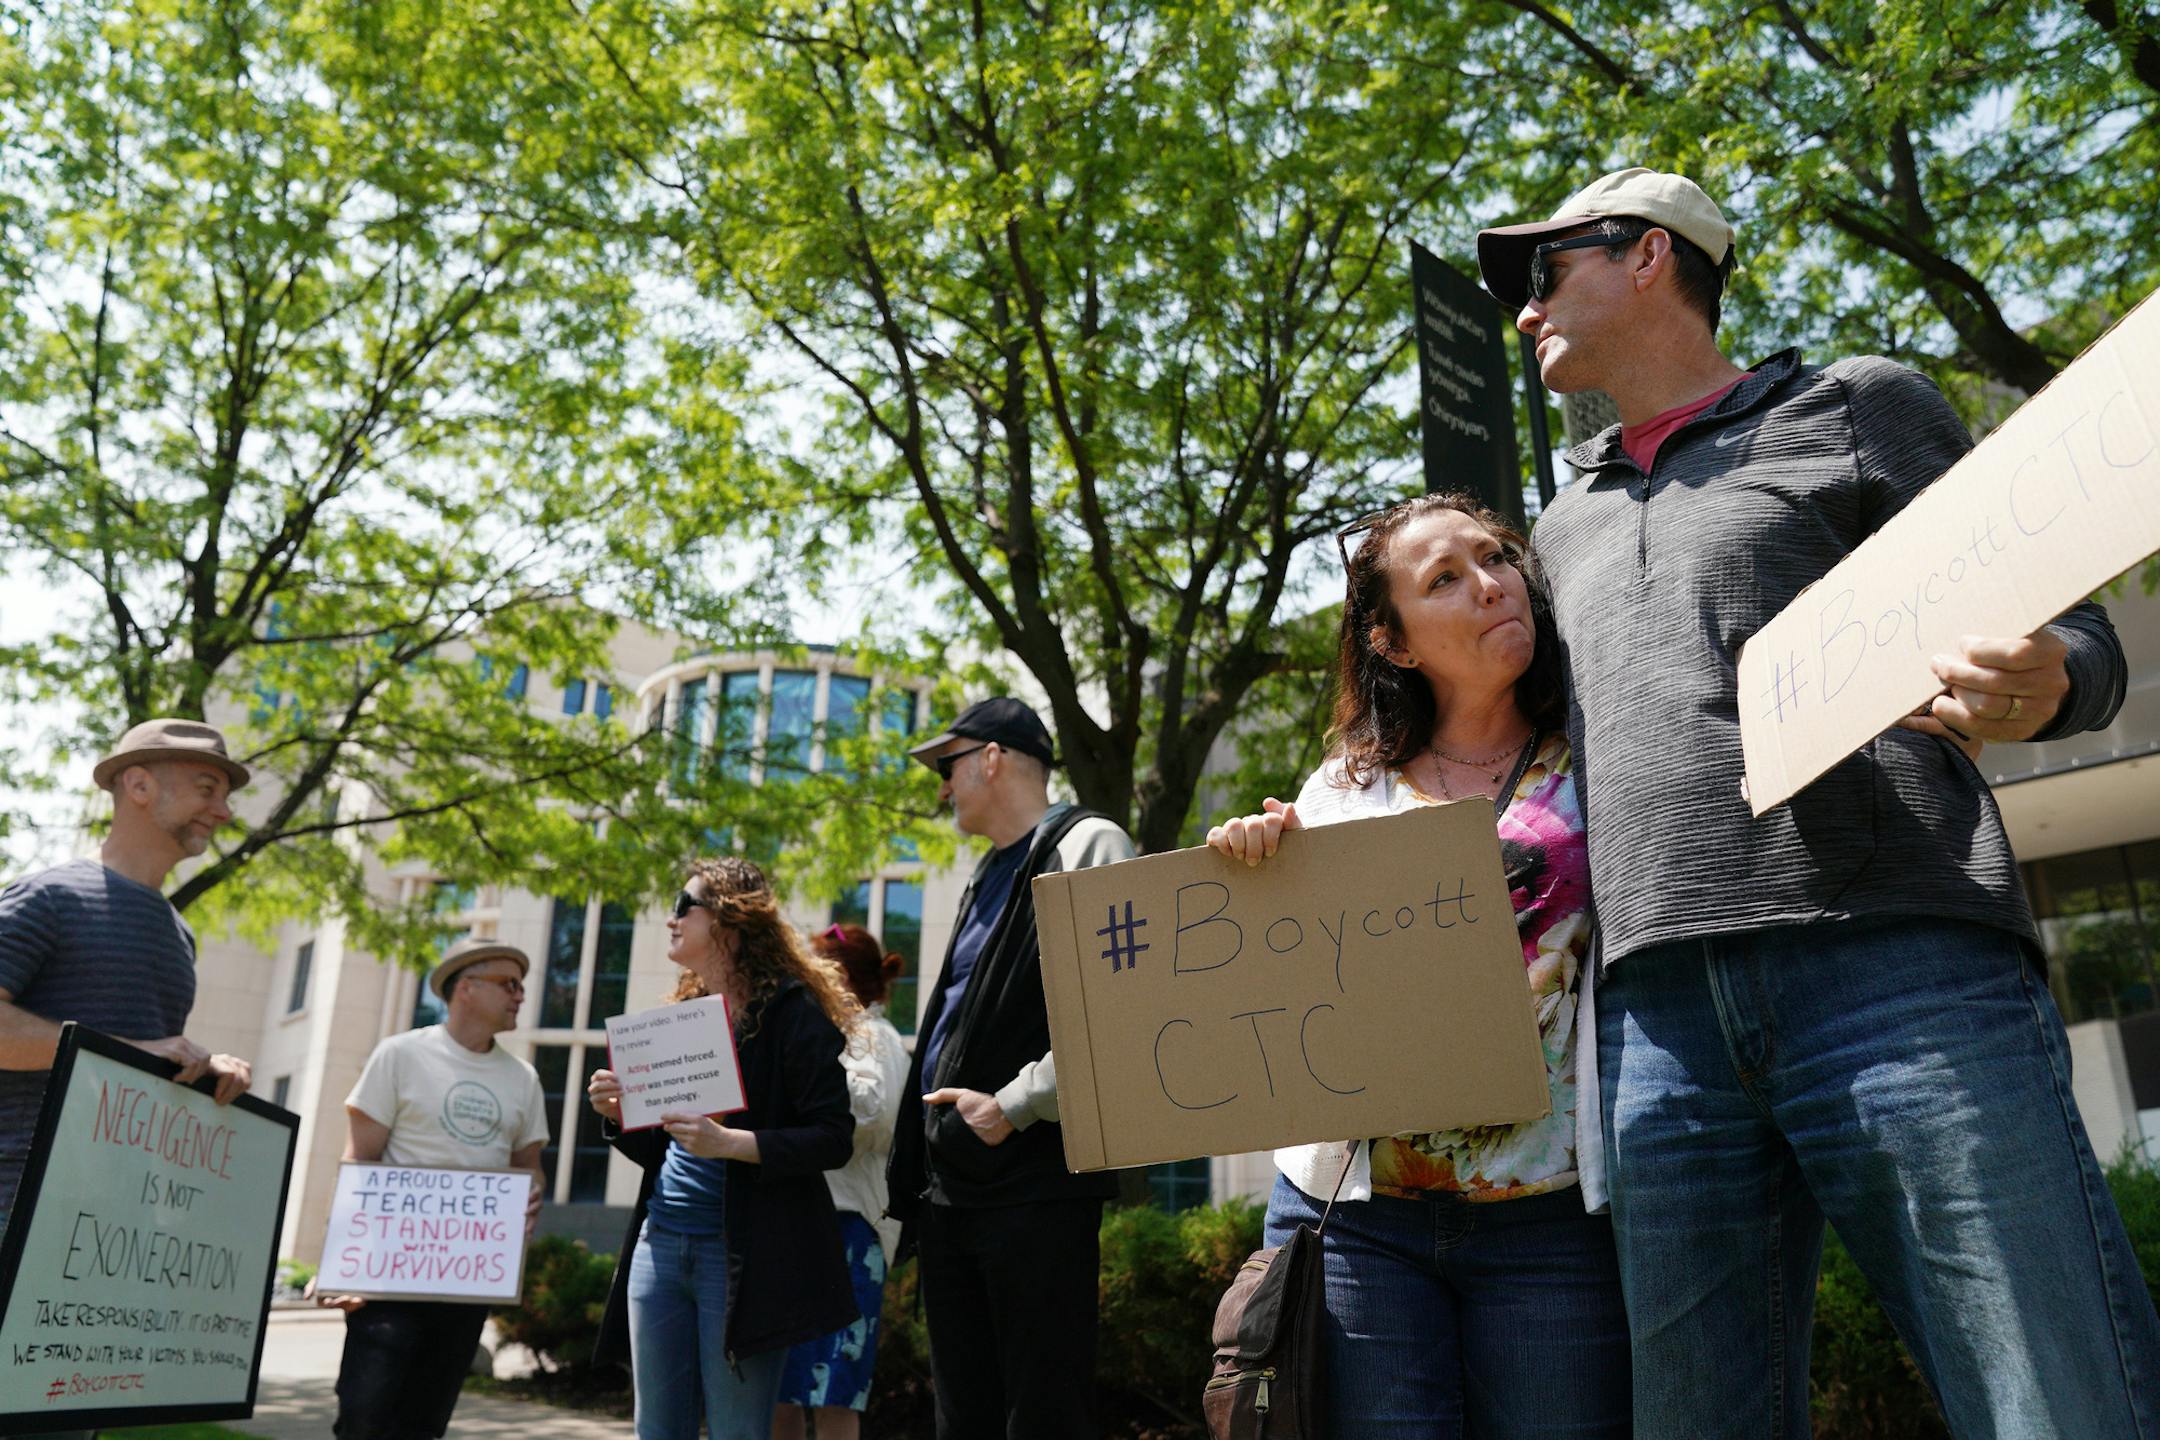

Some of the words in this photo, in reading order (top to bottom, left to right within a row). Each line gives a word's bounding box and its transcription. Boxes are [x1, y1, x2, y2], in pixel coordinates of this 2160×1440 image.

[616, 1026, 630, 1035] saw
[631, 1022, 648, 1034] your
[649, 1016, 673, 1029] video.
[677, 1008, 706, 1022] Here's
[614, 1043, 626, 1053] my
[1154, 1003, 1365, 1109] CTC
[627, 1063, 651, 1075] Acting
[651, 1056, 682, 1070] seemed
[684, 1049, 718, 1063] forced.
[625, 1082, 647, 1095] Script
[647, 1080, 662, 1089] was
[663, 1076, 686, 1087] more
[688, 1070, 720, 1082] excuse
[645, 1097, 662, 1107] than
[663, 1091, 701, 1105] apology.
[93, 1080, 238, 1180] NEGLIGENCE
[140, 1171, 161, 1204] IS
[164, 1180, 205, 1211] NOT
[367, 1171, 378, 1187] A
[385, 1170, 453, 1189] PROUD
[463, 1174, 512, 1194] CTC
[352, 1190, 498, 1216] TEACHER
[347, 1212, 507, 1242] STANDING
[63, 1210, 243, 1293] EXONERATION
[403, 1242, 449, 1254] WITH
[340, 1247, 506, 1283] SURVIVORS
[34, 1300, 76, 1328] TAKE
[189, 1313, 202, 1332] IT
[13, 1343, 40, 1366] WE
[43, 1344, 83, 1362] STAND
[86, 1345, 113, 1364] WITH
